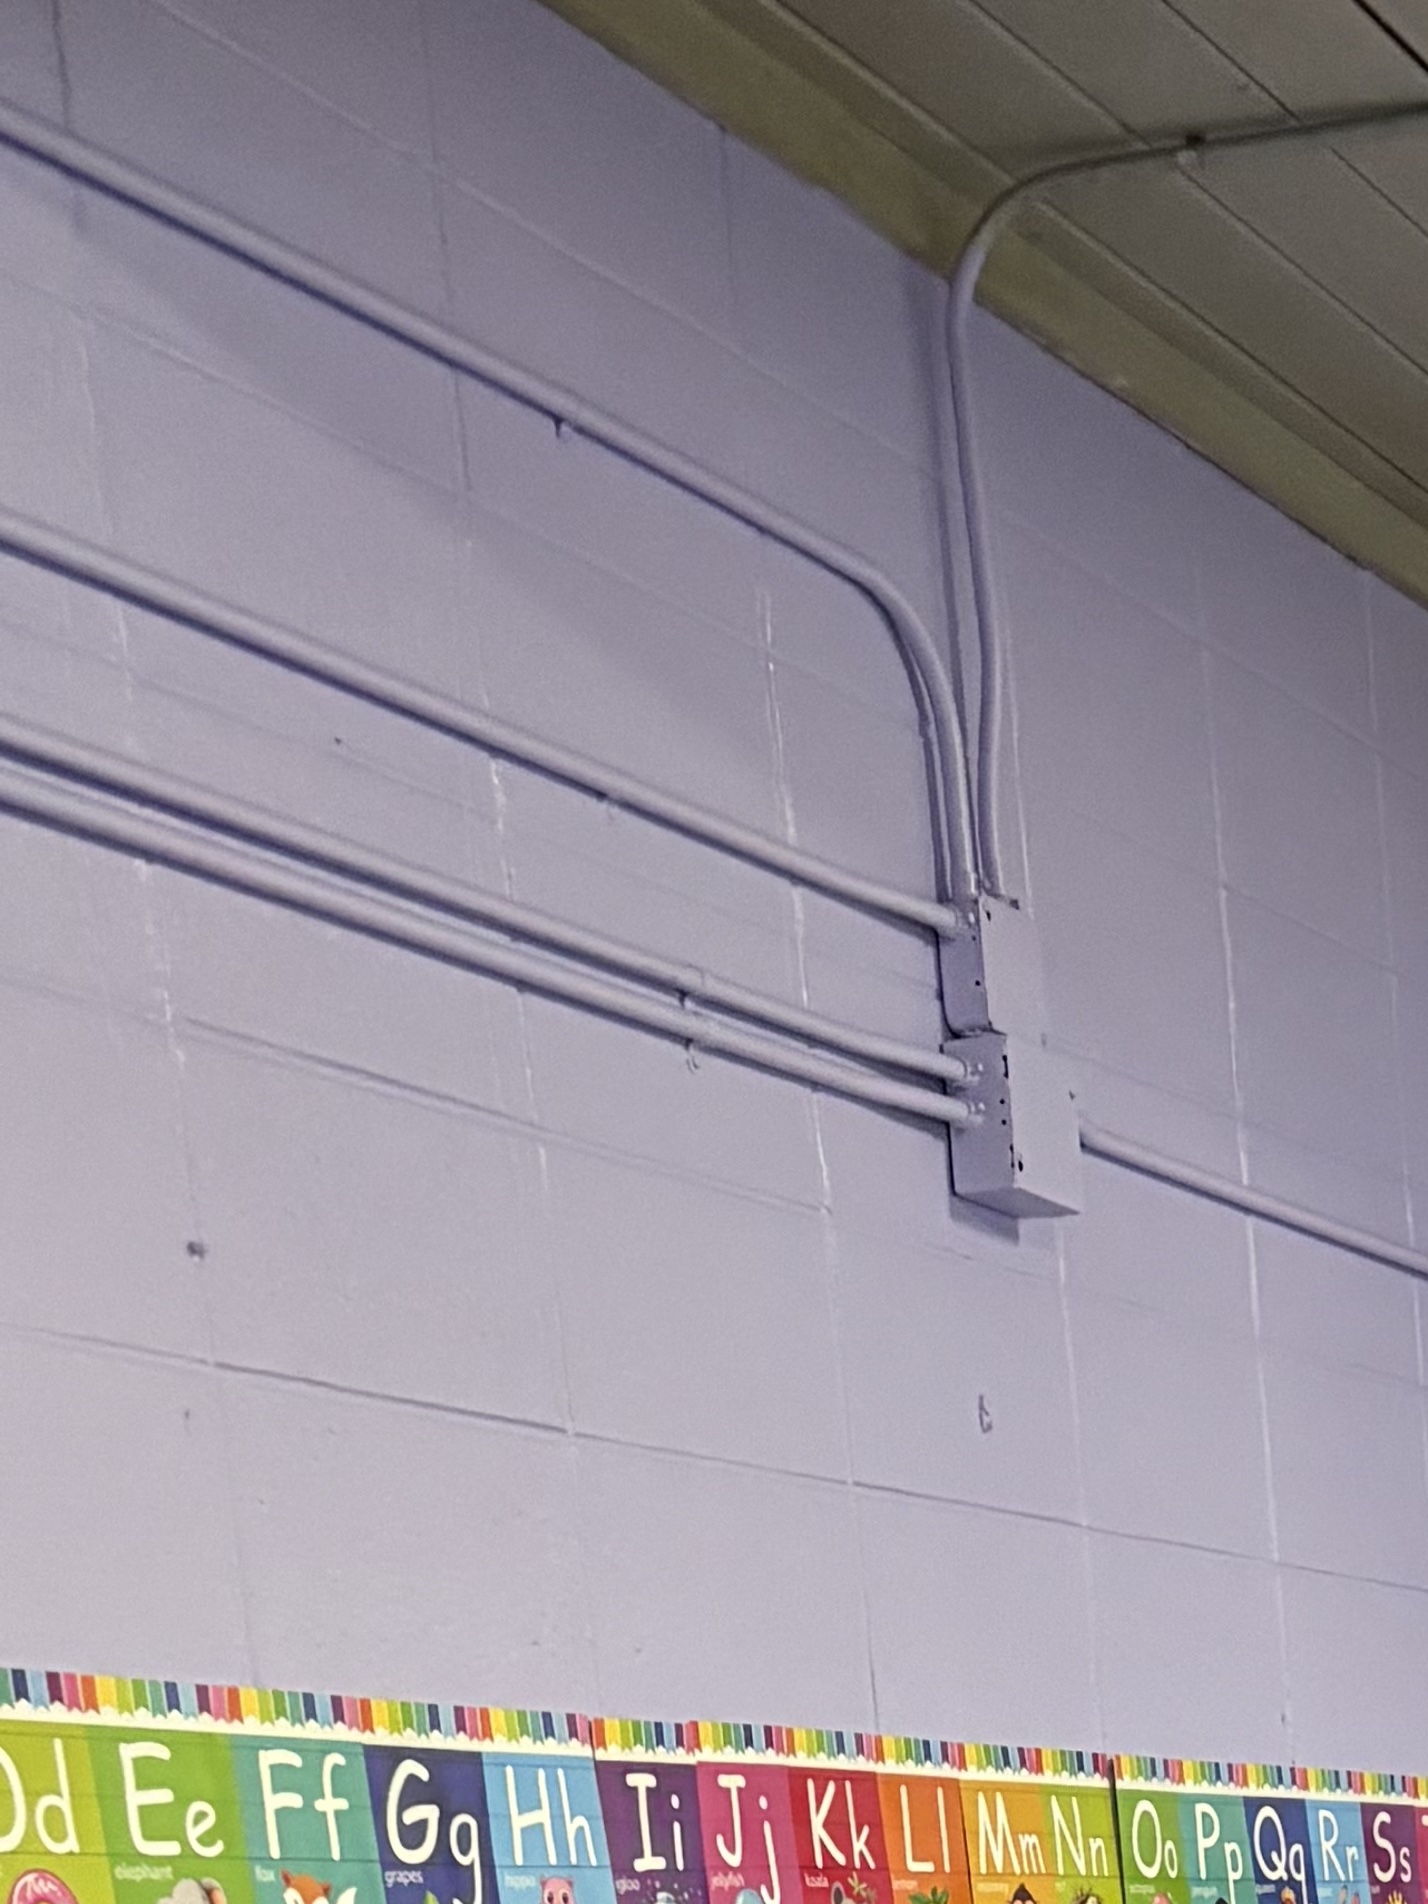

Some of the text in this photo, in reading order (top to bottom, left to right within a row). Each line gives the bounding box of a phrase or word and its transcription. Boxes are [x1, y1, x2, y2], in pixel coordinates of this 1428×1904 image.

[118, 1741, 225, 1857] Ee
[257, 1748, 350, 1862] Ff
[505, 1765, 598, 1867] Hh
[625, 1772, 685, 1872] Ii
[806, 1777, 876, 1870] Kk
[899, 1783, 951, 1874] Ll
[976, 1790, 1047, 1876] Mm
[1050, 1794, 1109, 1877] Nn
[1131, 1799, 1178, 1879] Oo
[384, 1869, 424, 1886] grapes
[1317, 1808, 1360, 1882] Rr
[1372, 1810, 1412, 1884] Ss
